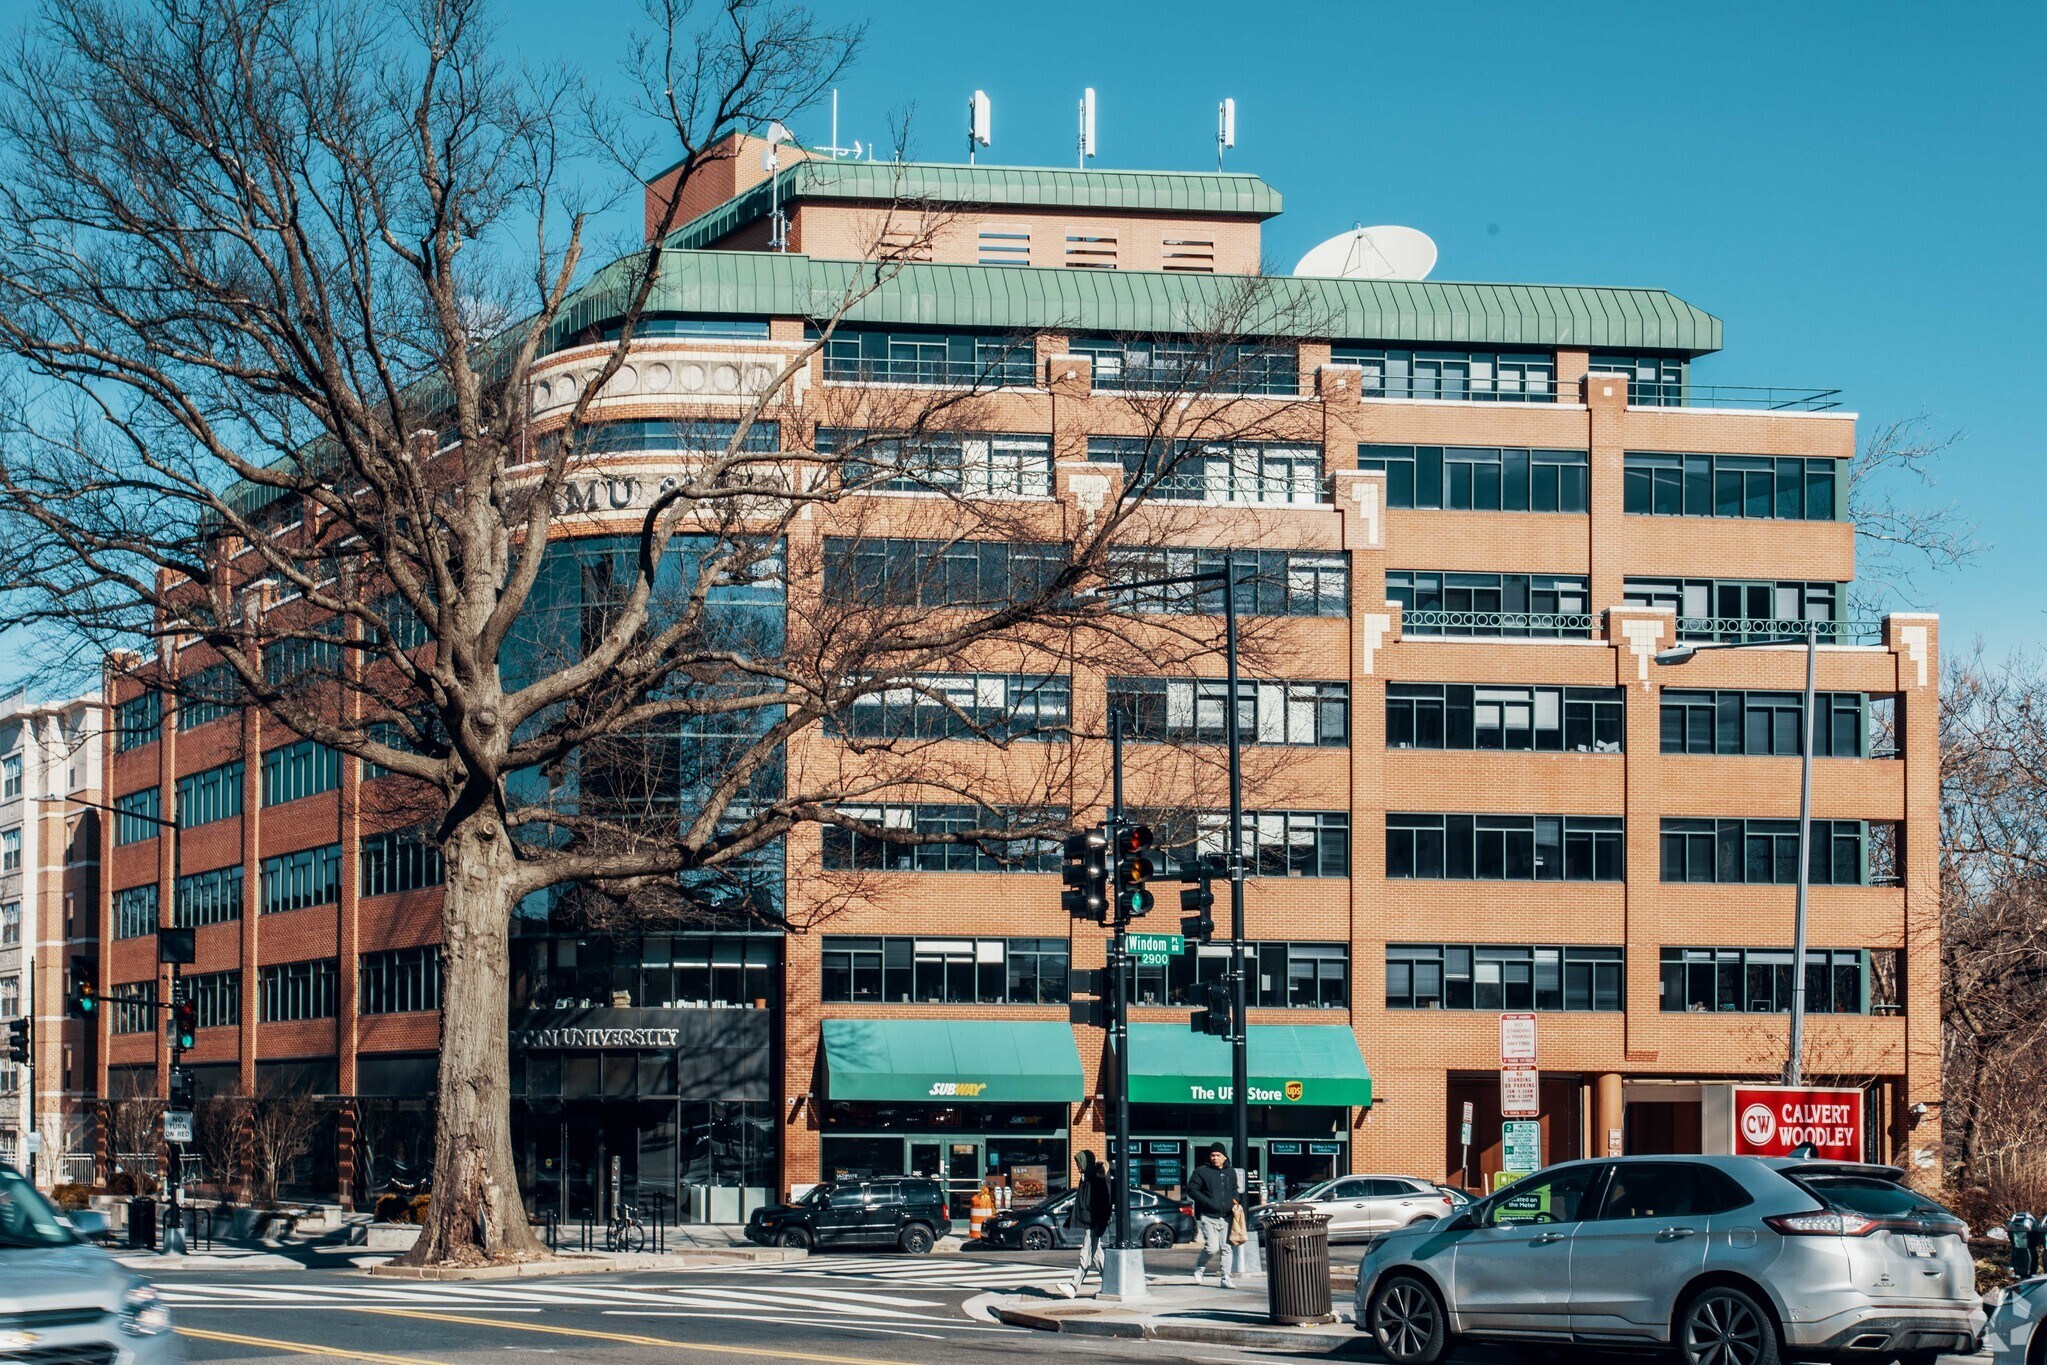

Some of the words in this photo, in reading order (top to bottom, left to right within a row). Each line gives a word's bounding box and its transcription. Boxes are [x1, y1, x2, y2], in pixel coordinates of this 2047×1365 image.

[1129, 935, 1167, 951] Windom
[1171, 936, 1179, 944] PL
[1142, 953, 1168, 964] 2900
[560, 1028, 680, 1046] UNIVERSITY
[928, 1082, 987, 1096] SUBWAY
[1190, 1086, 1215, 1100] The
[1247, 1086, 1283, 1101] Store
[1781, 1103, 1851, 1124] CALVERT
[1506, 1124, 1512, 1132] 2
[1746, 1115, 1771, 1134] CW
[1778, 1126, 1854, 1147] WOODLEY
